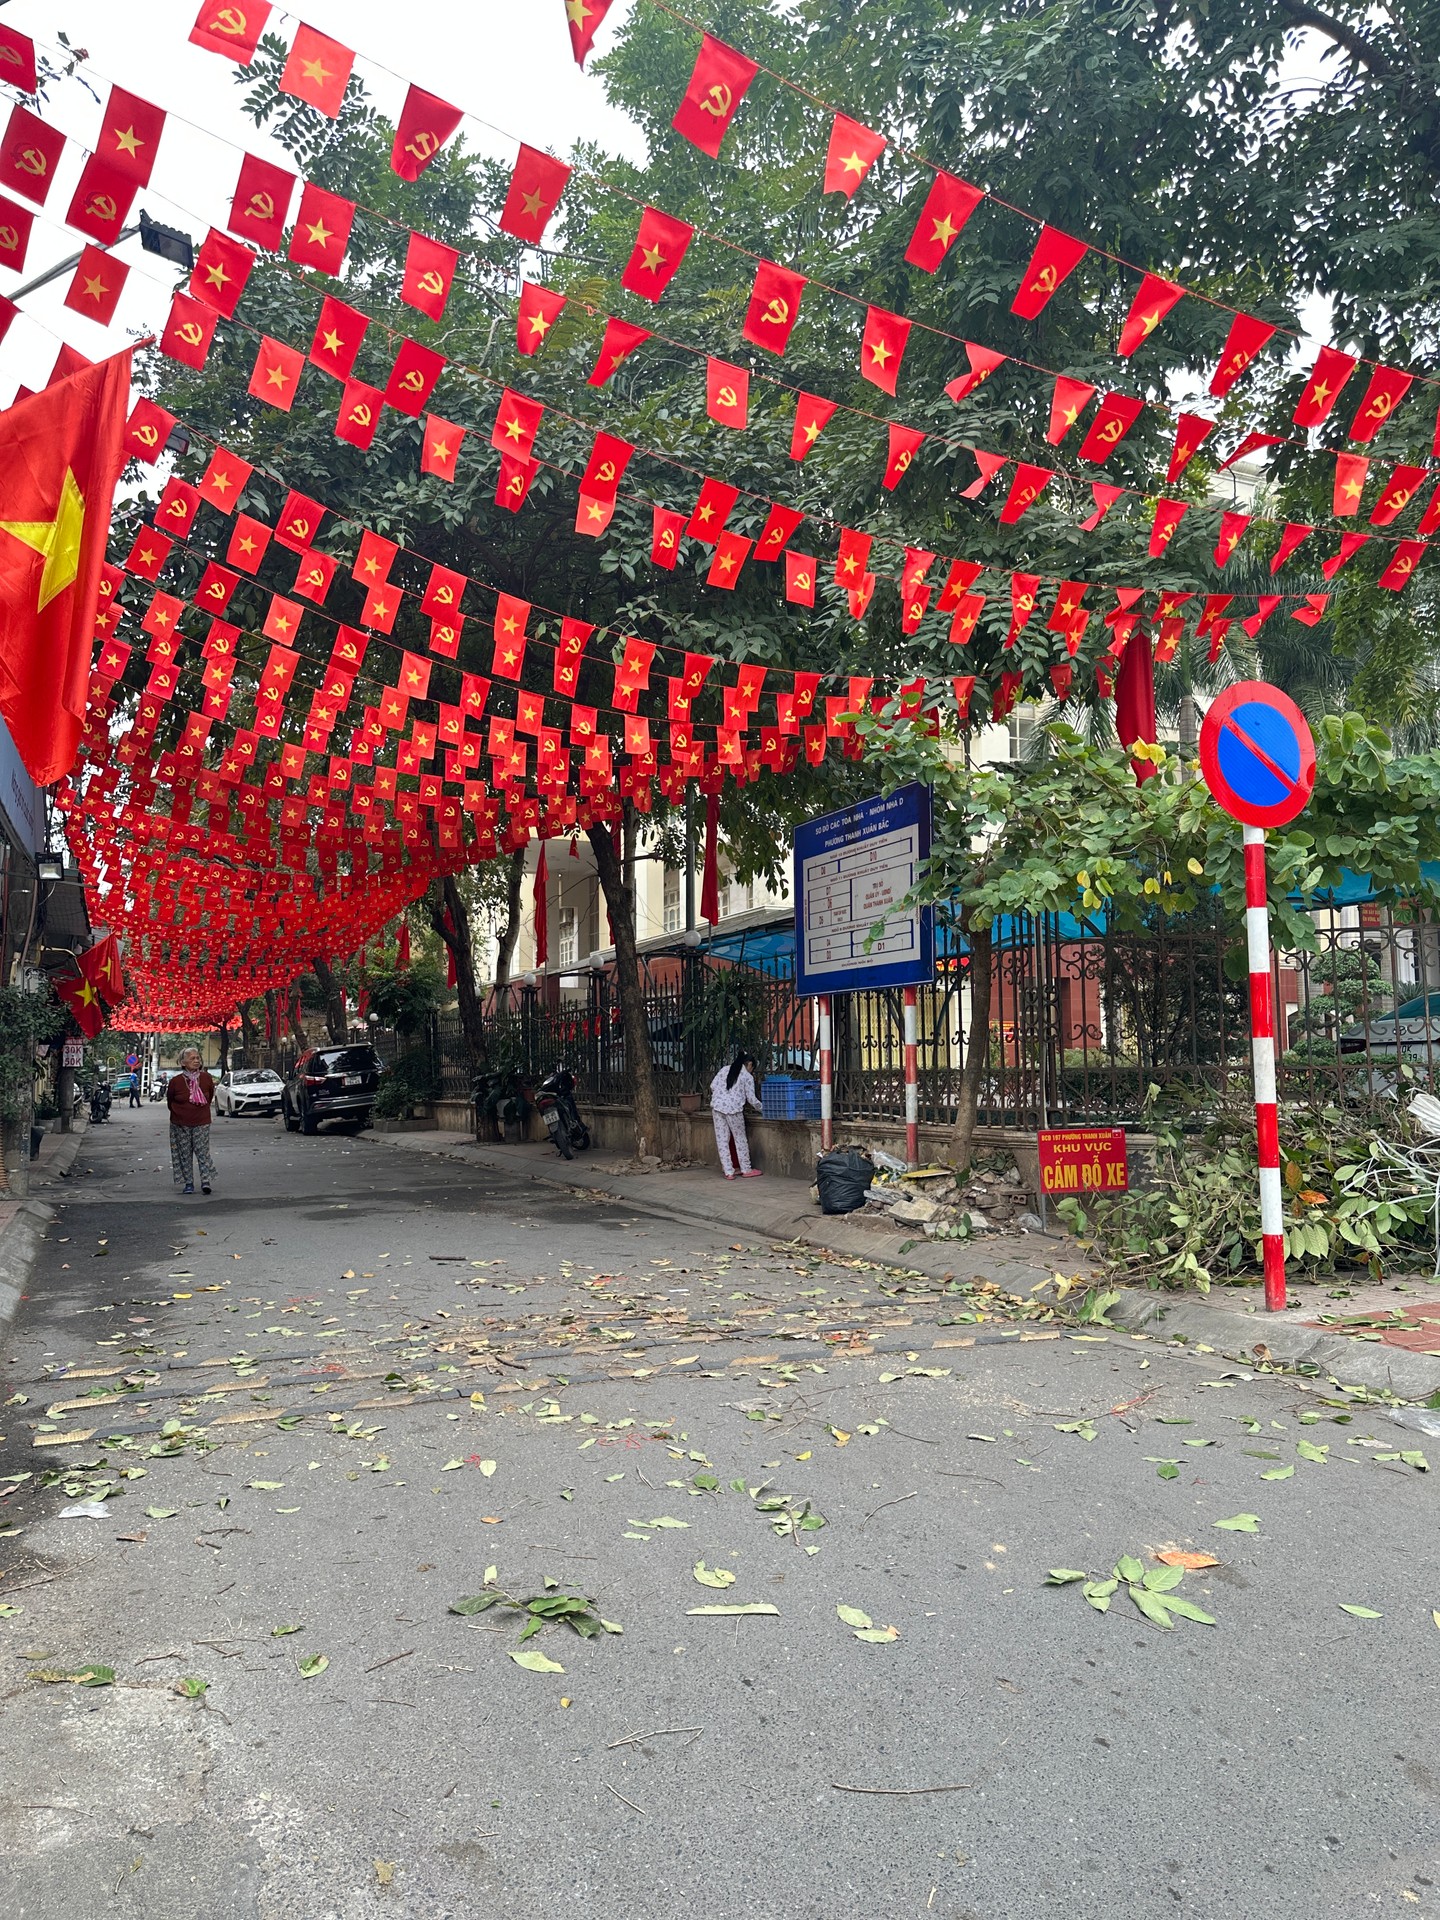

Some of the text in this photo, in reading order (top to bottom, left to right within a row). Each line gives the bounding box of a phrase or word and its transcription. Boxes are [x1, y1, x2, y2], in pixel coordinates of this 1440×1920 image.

[830, 819, 840, 830] CÁC
[853, 809, 864, 821] NHÀ
[869, 802, 885, 816] NHÓM
[886, 797, 898, 810] NHÀ
[899, 797, 904, 806] D
[845, 829, 861, 842] THANH
[862, 822, 877, 836] XUÂN
[878, 816, 890, 830] BẮC
[877, 942, 885, 951] D1
[65, 1046, 82, 1055] 30K
[65, 1057, 81, 1066] 50K
[1061, 1131, 1081, 1140] PHƯỜNG
[1082, 1132, 1098, 1140] THANH
[1098, 1131, 1112, 1139] XUÂN
[1053, 1142, 1112, 1154] KHU VỰC
[1043, 1154, 1126, 1190] CẤM ĐỖ XE
